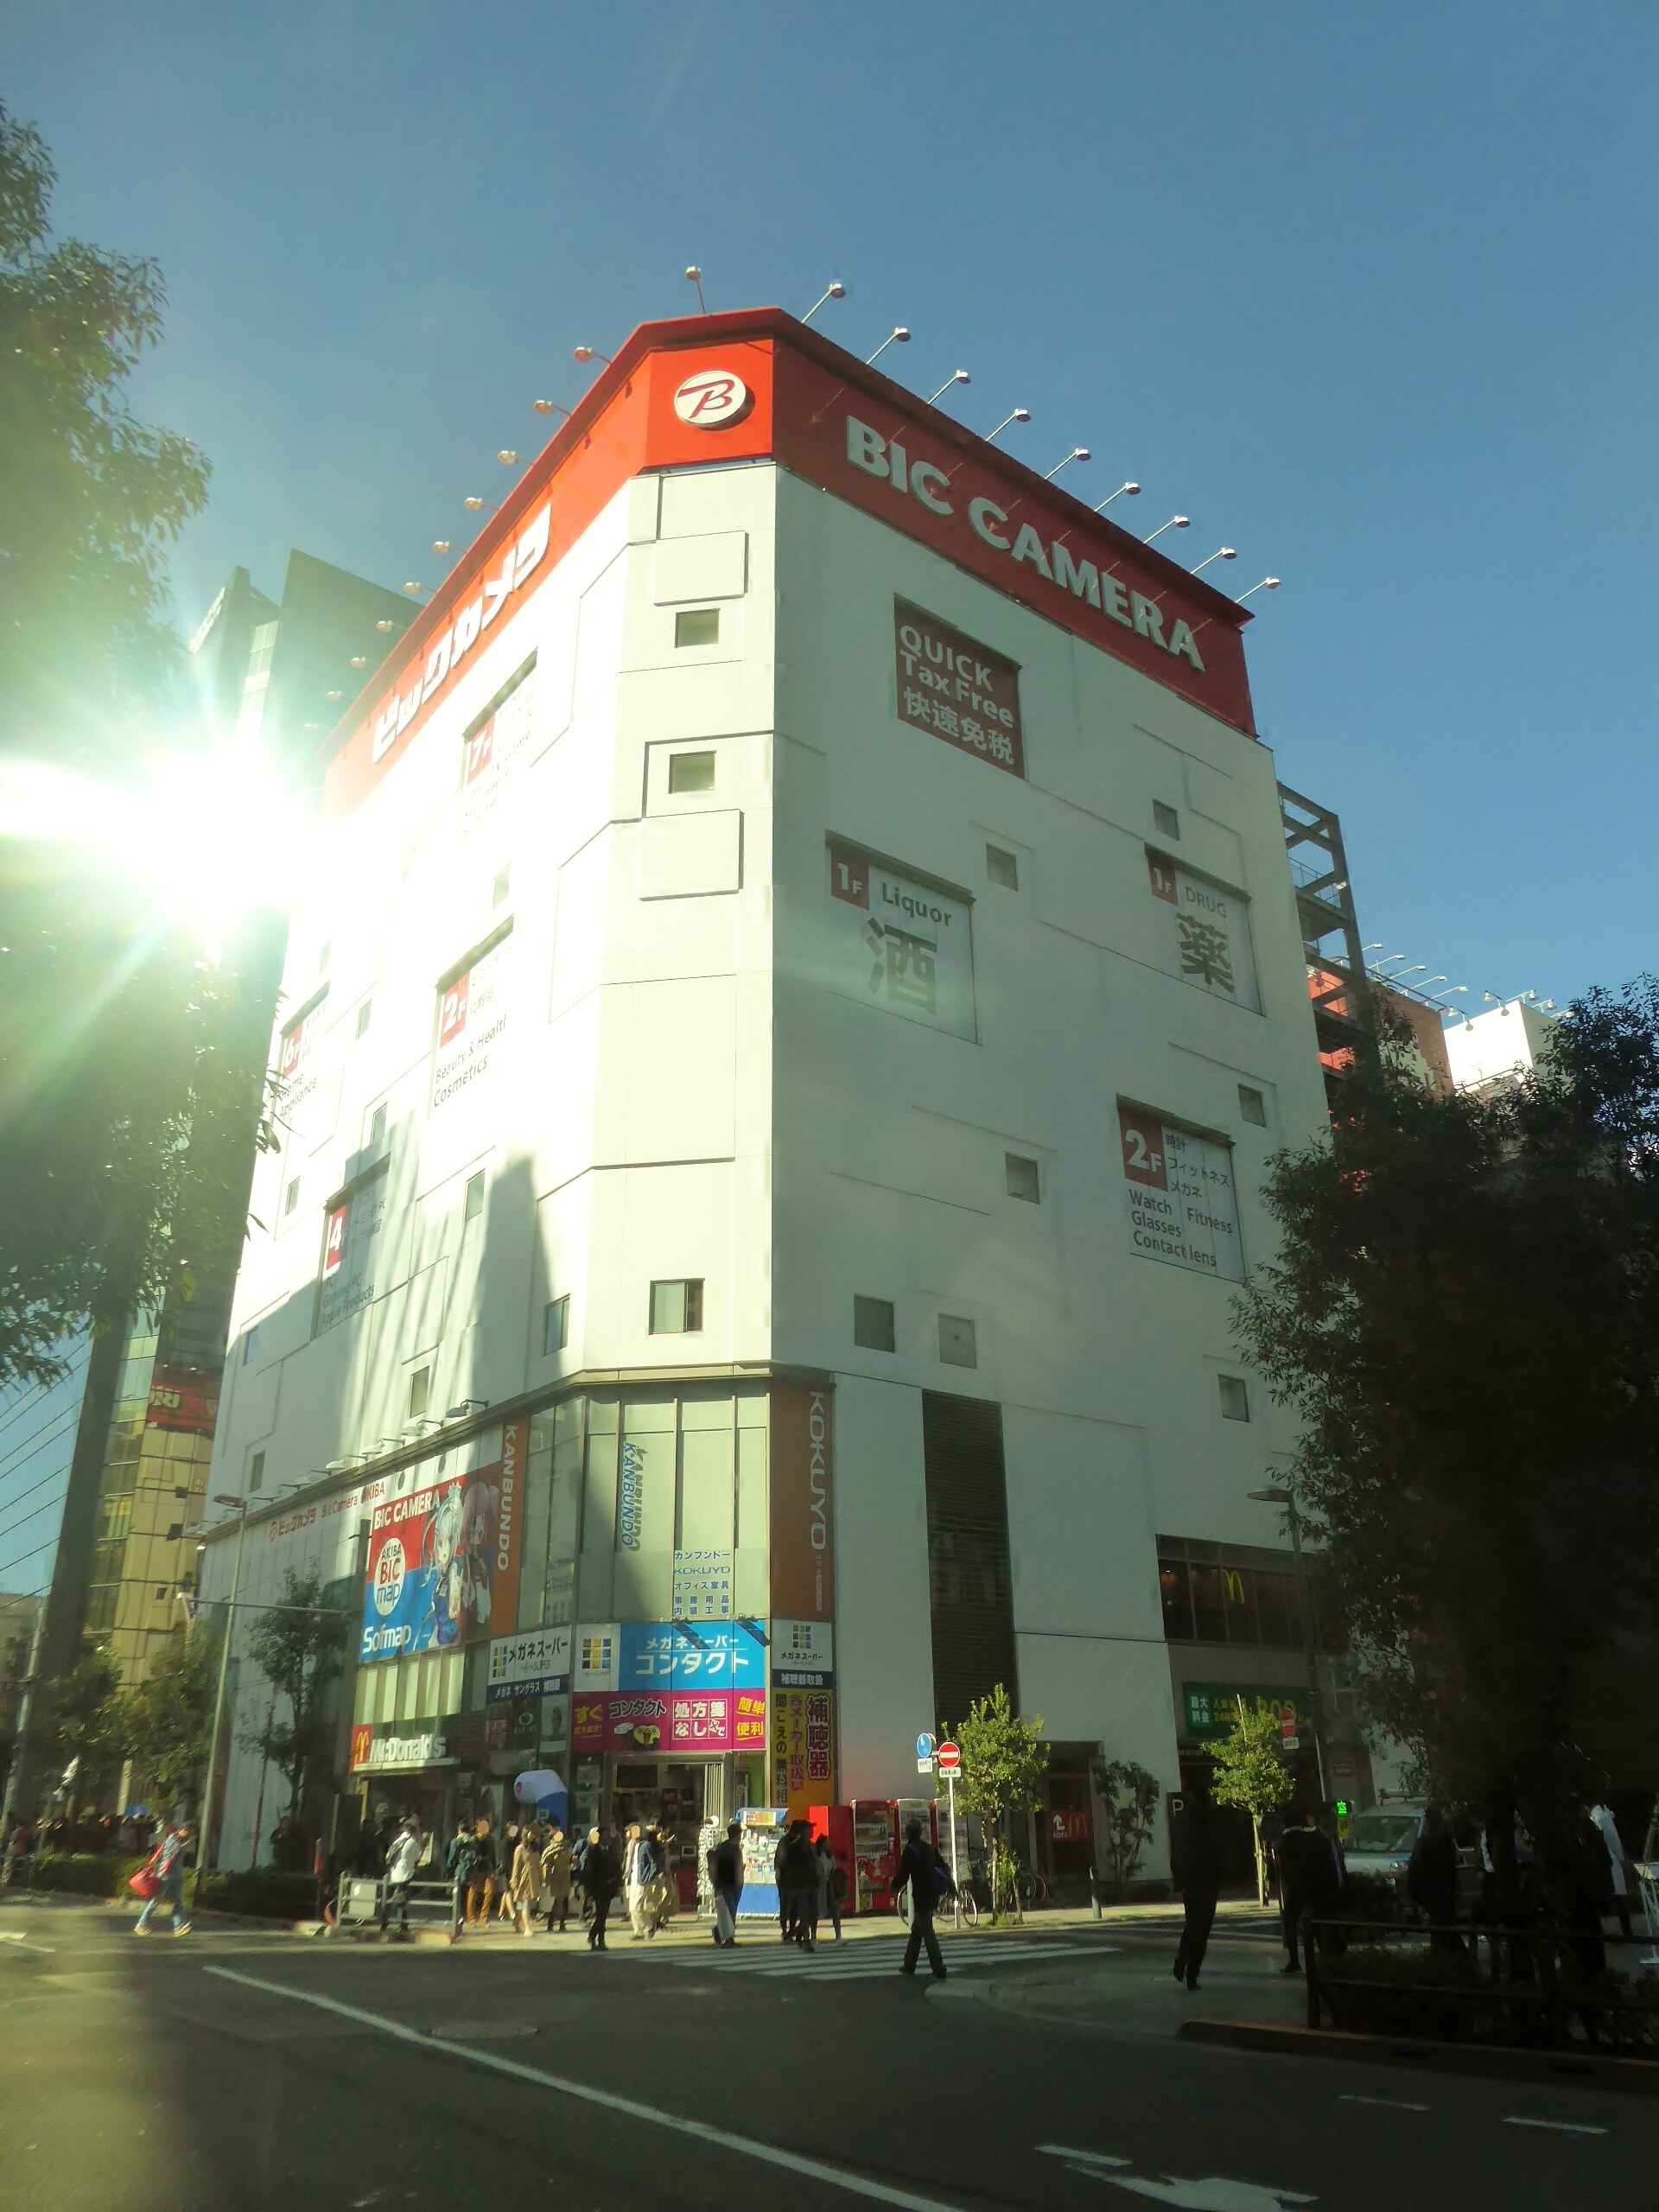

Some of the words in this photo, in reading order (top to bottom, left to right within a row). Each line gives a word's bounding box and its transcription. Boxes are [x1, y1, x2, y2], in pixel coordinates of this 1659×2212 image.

[846, 416, 955, 517] BIC
[967, 496, 1206, 674] CAMERA
[899, 625, 994, 693] QUICK
[900, 650, 950, 696] Tax
[956, 678, 1014, 730] Free
[902, 686, 1014, 766] 快速免税
[836, 861, 864, 893] 1F
[1153, 865, 1173, 895] 1F
[880, 880, 952, 928] Liquor
[1185, 885, 1229, 919] DRUG
[865, 917, 938, 1016] 酒
[1176, 912, 1236, 995] 薬
[442, 992, 468, 1035] 2F
[434, 1054, 488, 1108] Cosmetics
[435, 1051, 467, 1084] Beauty
[1124, 1128, 1163, 1173] 2F
[1167, 1156, 1230, 1188] フィットネス
[1128, 1188, 1173, 1217] Watch
[1130, 1210, 1182, 1238] Glasses
[1186, 1205, 1233, 1234] Fitness
[1133, 1229, 1188, 1260] Contact
[1189, 1244, 1217, 1268] lens
[808, 1389, 827, 1551] KOKUYO
[361, 1481, 385, 1504] AKIBA
[498, 1424, 518, 1572] KANBUNDO
[621, 1441, 637, 1547] KANBUNDO
[373, 1510, 392, 1531] BIC
[393, 1490, 442, 1522] CAMERA
[380, 1542, 402, 1560] AKIBA
[378, 1558, 401, 1586] BIC
[674, 1566, 731, 1575] KOKUYO
[376, 1582, 401, 1606] map
[361, 1624, 412, 1656] Sofmap
[508, 1636, 569, 1664] メガネスーパー
[646, 1635, 740, 1650] メガネーパー
[781, 1651, 823, 1661] メガネスーパー
[635, 1650, 750, 1675] コンタクト
[608, 1696, 668, 1720] コンタクト
[674, 1700, 726, 1719] 処方箋
[738, 1696, 766, 1715] 簡単
[736, 1720, 764, 1737] 便利
[806, 1694, 830, 1781] 補聴器
[369, 1732, 448, 1764] McDonald's
[775, 1758, 788, 1808] 無料相
[1171, 1798, 1184, 1817] P
